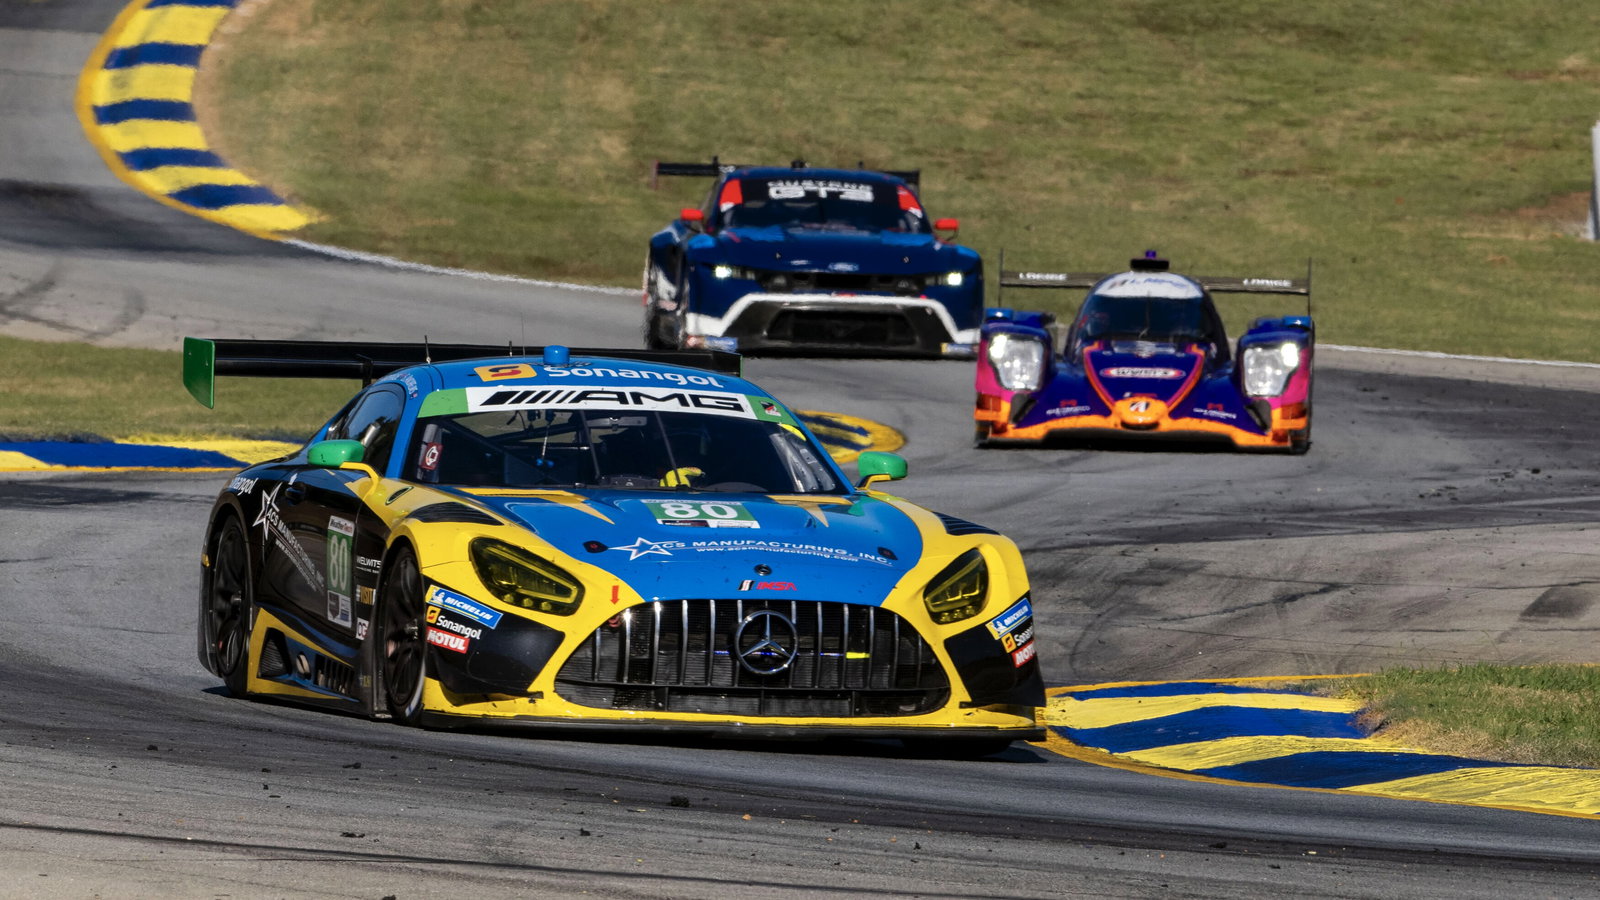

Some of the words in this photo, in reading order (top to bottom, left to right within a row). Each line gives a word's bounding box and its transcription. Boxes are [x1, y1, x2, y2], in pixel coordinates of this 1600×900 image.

[546, 365, 724, 389] Sonangol
[567, 390, 745, 413] AMG
[660, 503, 739, 519] 80
[330, 534, 348, 591] 80
[650, 542, 686, 550] ACS
[859, 552, 893, 565] INC.
[696, 546, 859, 563] www.acsmanufacturing.com
[756, 581, 798, 591] IMSA
[444, 596, 494, 620] MICHELIN
[436, 615, 482, 640] Sonangol
[427, 629, 466, 651] MOTUL
